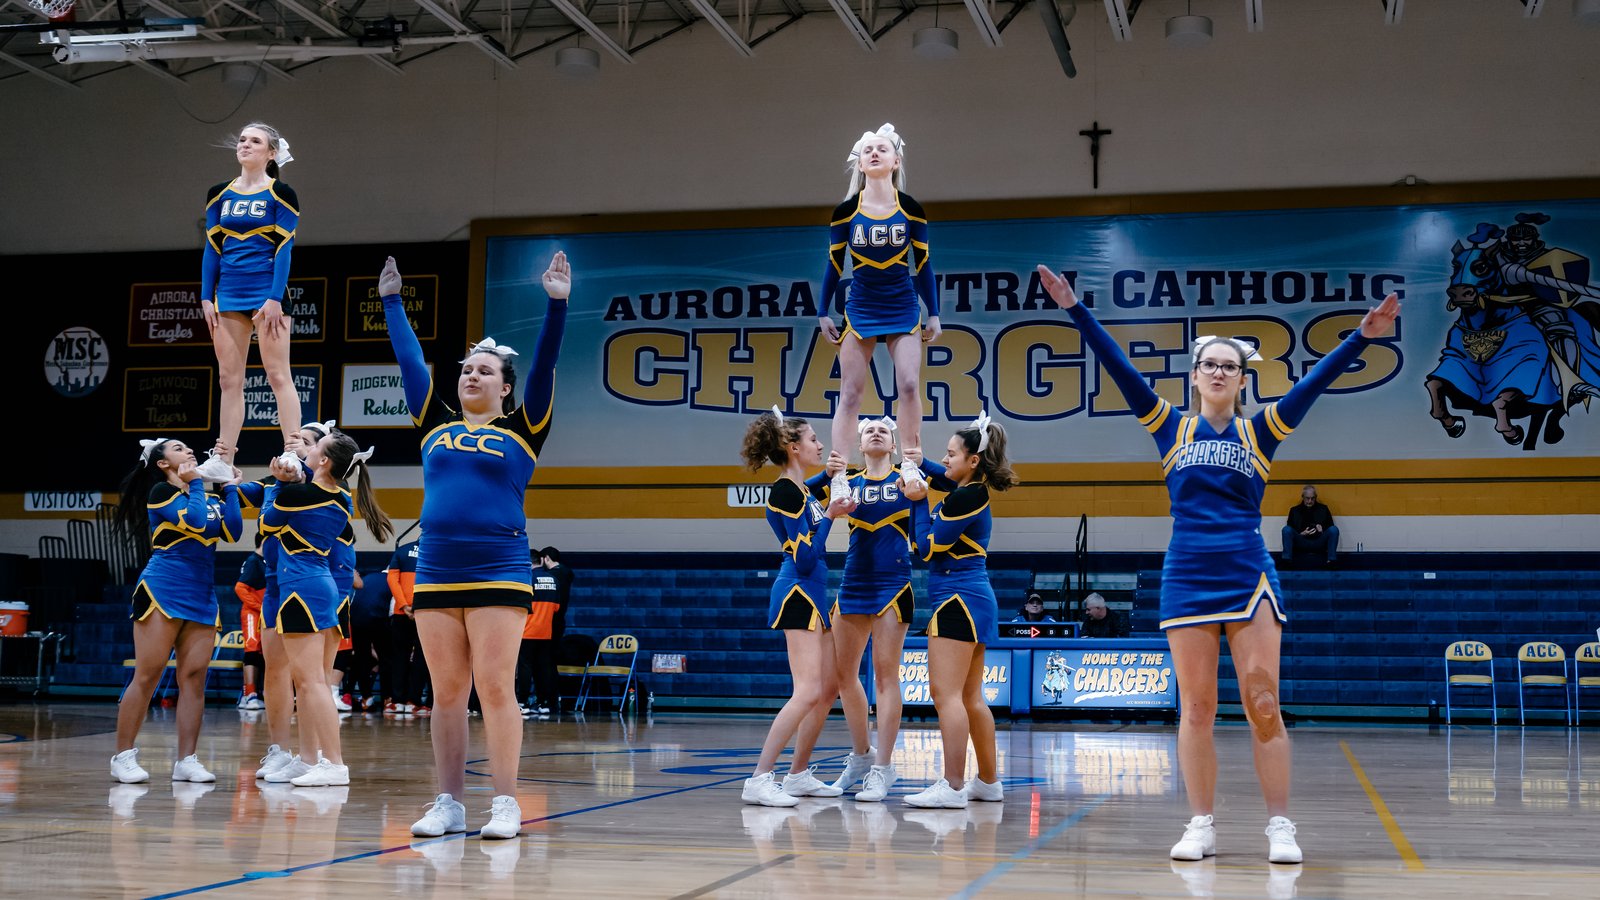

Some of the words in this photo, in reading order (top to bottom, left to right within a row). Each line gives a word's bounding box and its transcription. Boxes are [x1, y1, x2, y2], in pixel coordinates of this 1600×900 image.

[220, 199, 267, 218] ACC
[851, 223, 907, 248] ACC
[150, 291, 197, 306] AURORA
[603, 280, 818, 322] AURORA
[1112, 269, 1406, 308] CATHOLIC
[140, 307, 205, 321] CHRISTIAN
[148, 322, 194, 343] Eagles
[54, 337, 102, 361] MSC
[602, 308, 1405, 422] CHARGERS
[138, 376, 198, 392] ELMWOOD
[152, 394, 182, 405] PARK
[363, 398, 409, 416] Rebels
[145, 407, 188, 427] Tigers
[427, 431, 505, 458] ACC
[1175, 440, 1256, 478] CHARGERS
[31, 491, 95, 509] VISITORS
[605, 637, 633, 649] ACC
[1453, 643, 1485, 657] ACC
[1526, 644, 1558, 658] ACC
[1081, 653, 1119, 666] HOME
[1121, 653, 1138, 666] OF
[1140, 653, 1165, 666] THE
[1073, 667, 1171, 693] CHARGERS
